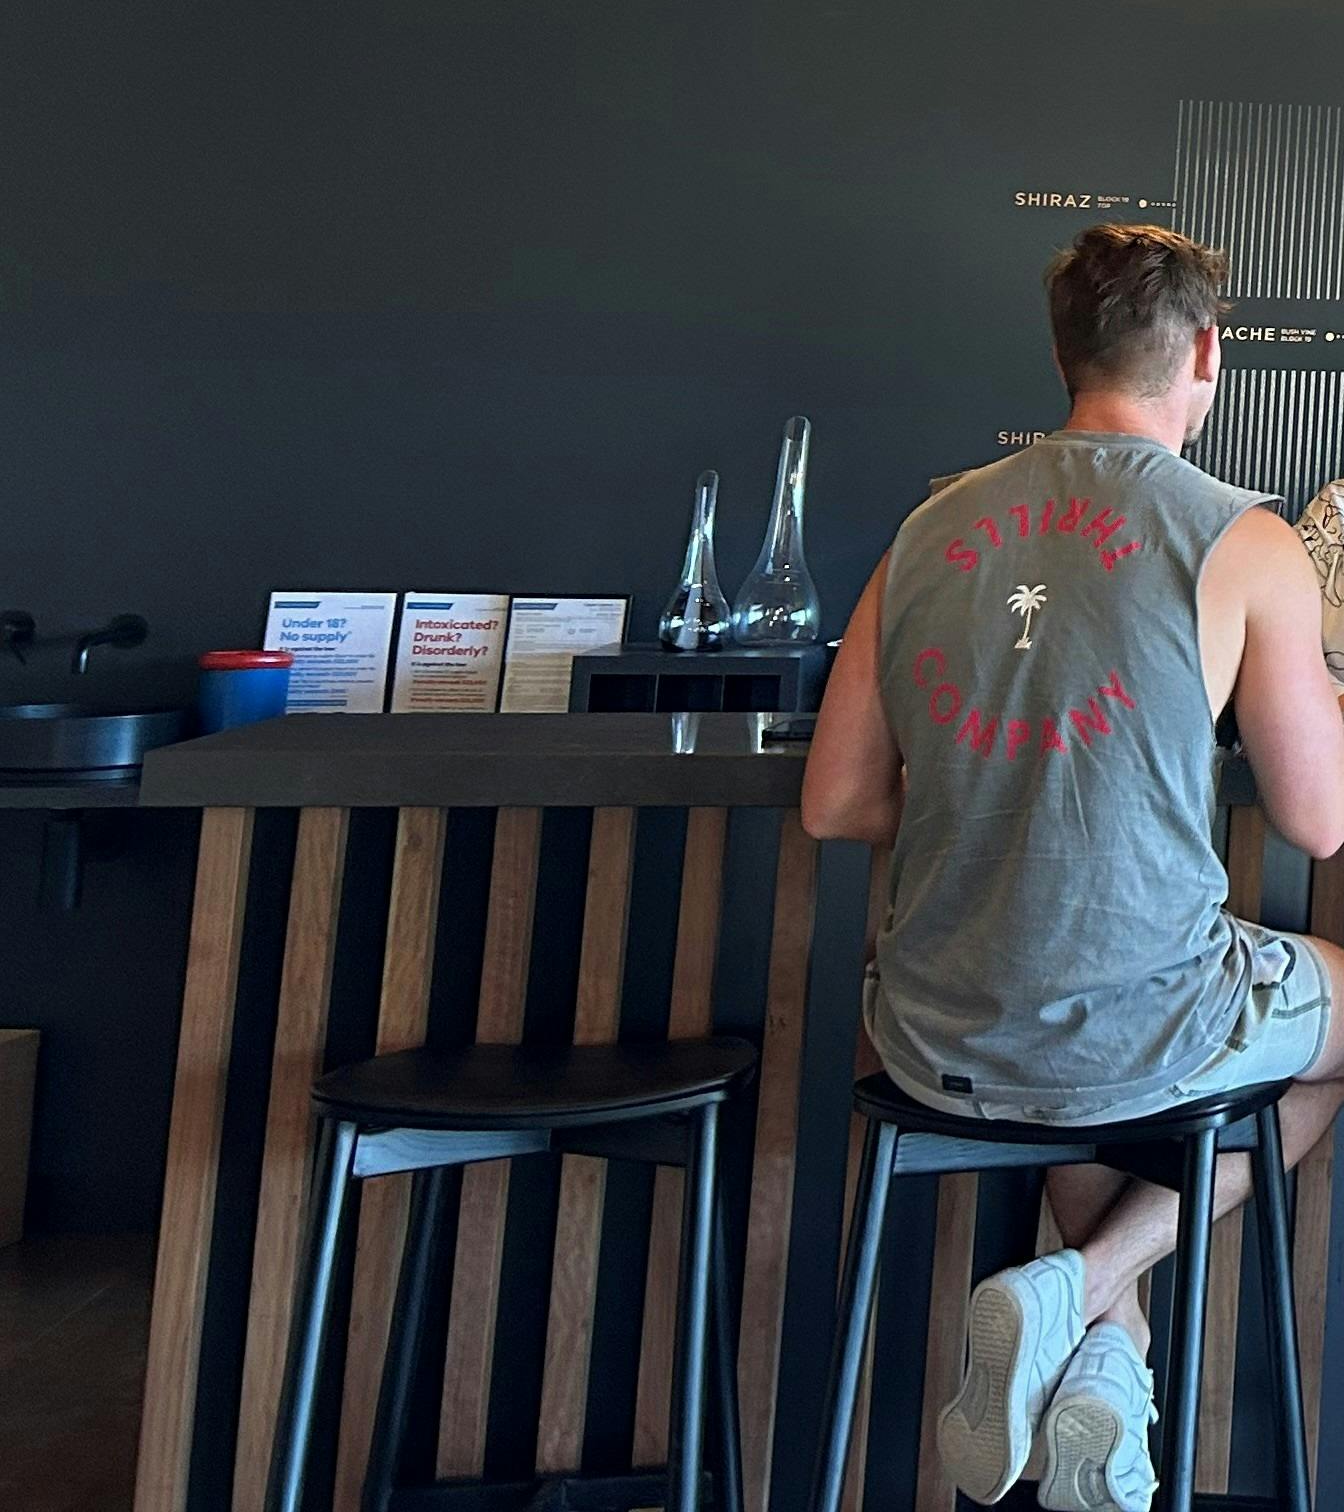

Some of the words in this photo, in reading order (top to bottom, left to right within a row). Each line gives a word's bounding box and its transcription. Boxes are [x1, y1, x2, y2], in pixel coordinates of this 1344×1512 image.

[1015, 193, 1091, 208] SHIRAZ
[1222, 327, 1275, 341] ACHE
[945, 497, 1142, 572] THRILLS
[282, 618, 323, 628] Under
[326, 618, 348, 629] 18?
[415, 619, 499, 630] Intoxicated?
[280, 631, 299, 642] No
[413, 632, 462, 643] Drunk?
[412, 645, 489, 658] Disorderly?
[912, 647, 1137, 762] COMPANY
